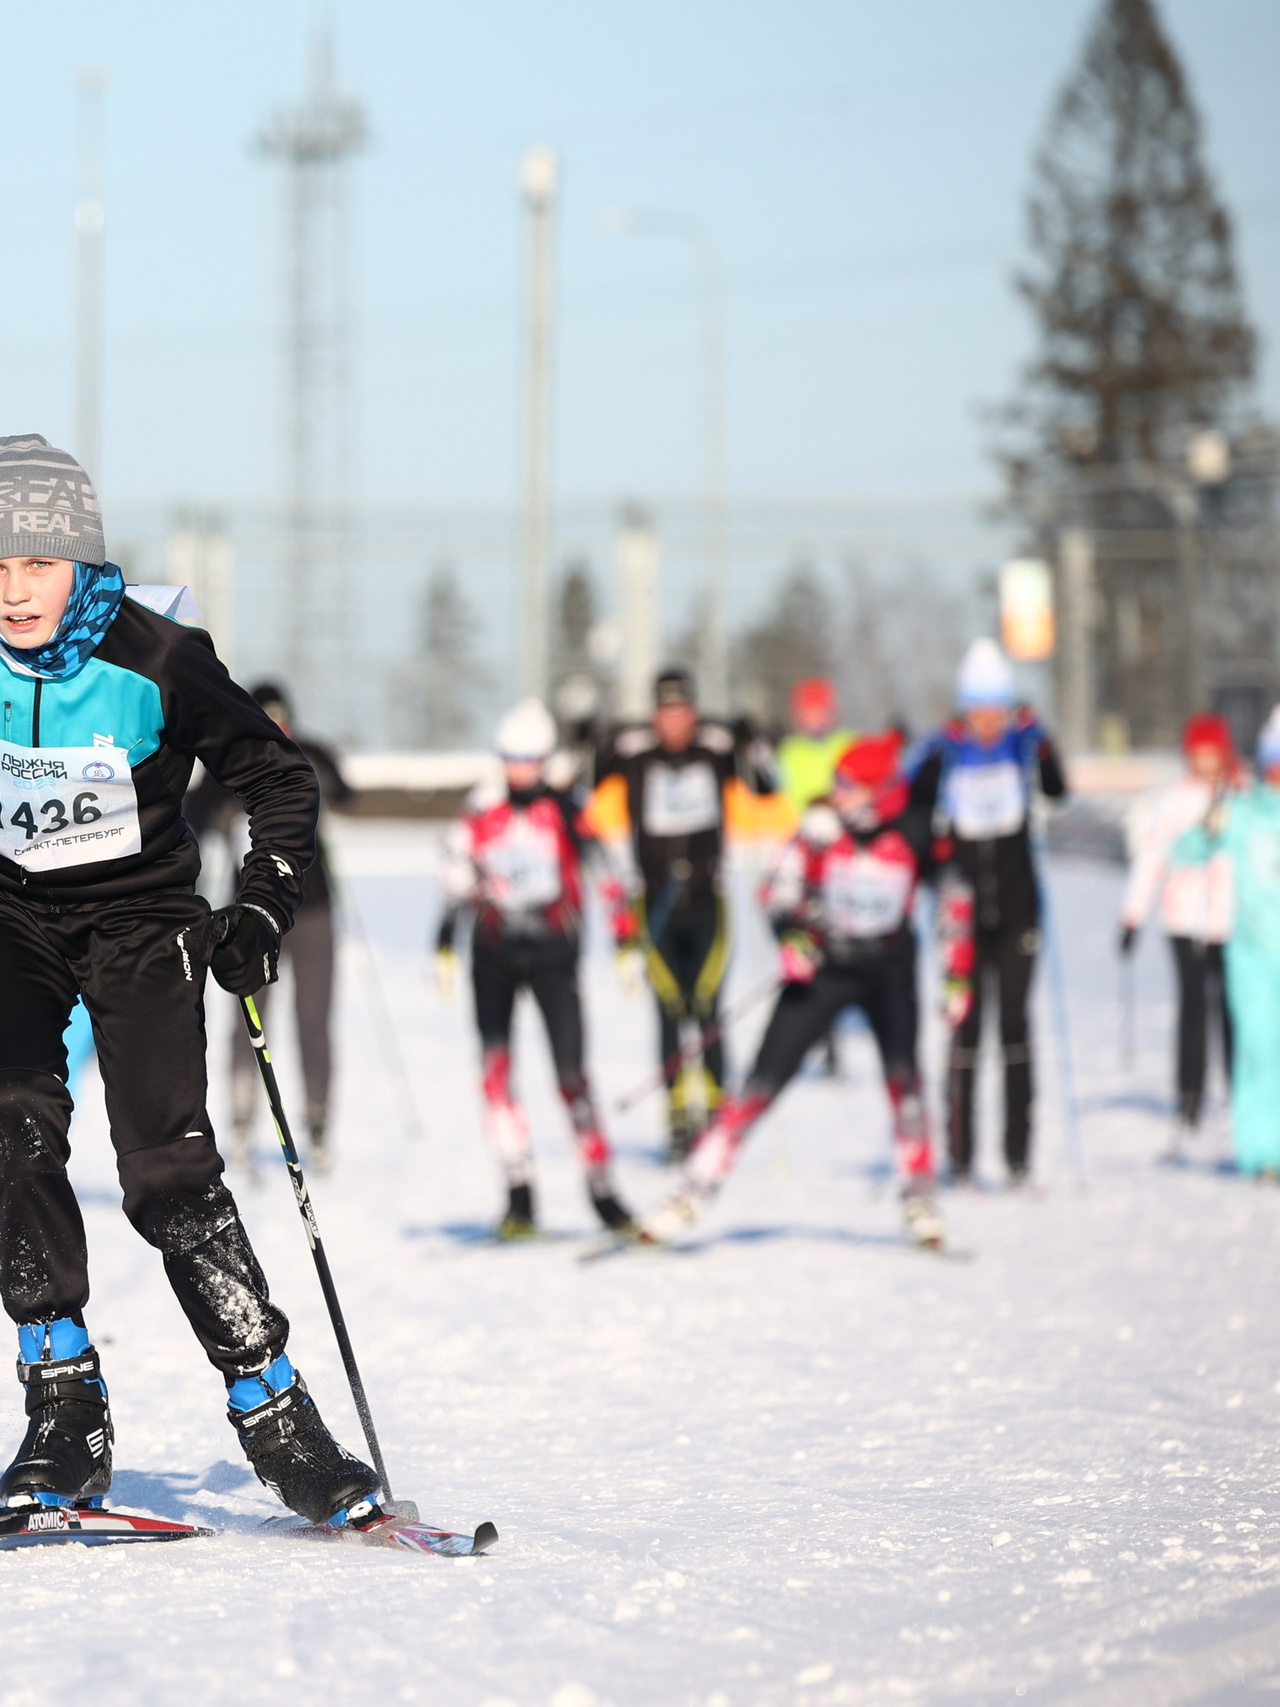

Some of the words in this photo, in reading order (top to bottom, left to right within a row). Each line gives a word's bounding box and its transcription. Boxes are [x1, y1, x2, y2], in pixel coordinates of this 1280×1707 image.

[12, 510, 80, 538] REAL
[0, 760, 68, 780] РОССИИ
[1, 752, 65, 771] ЛЫЖНЯ
[40, 1360, 95, 1380] SPINE
[242, 1395, 293, 1428] SPINE
[27, 1511, 65, 1531] ATOMIC
